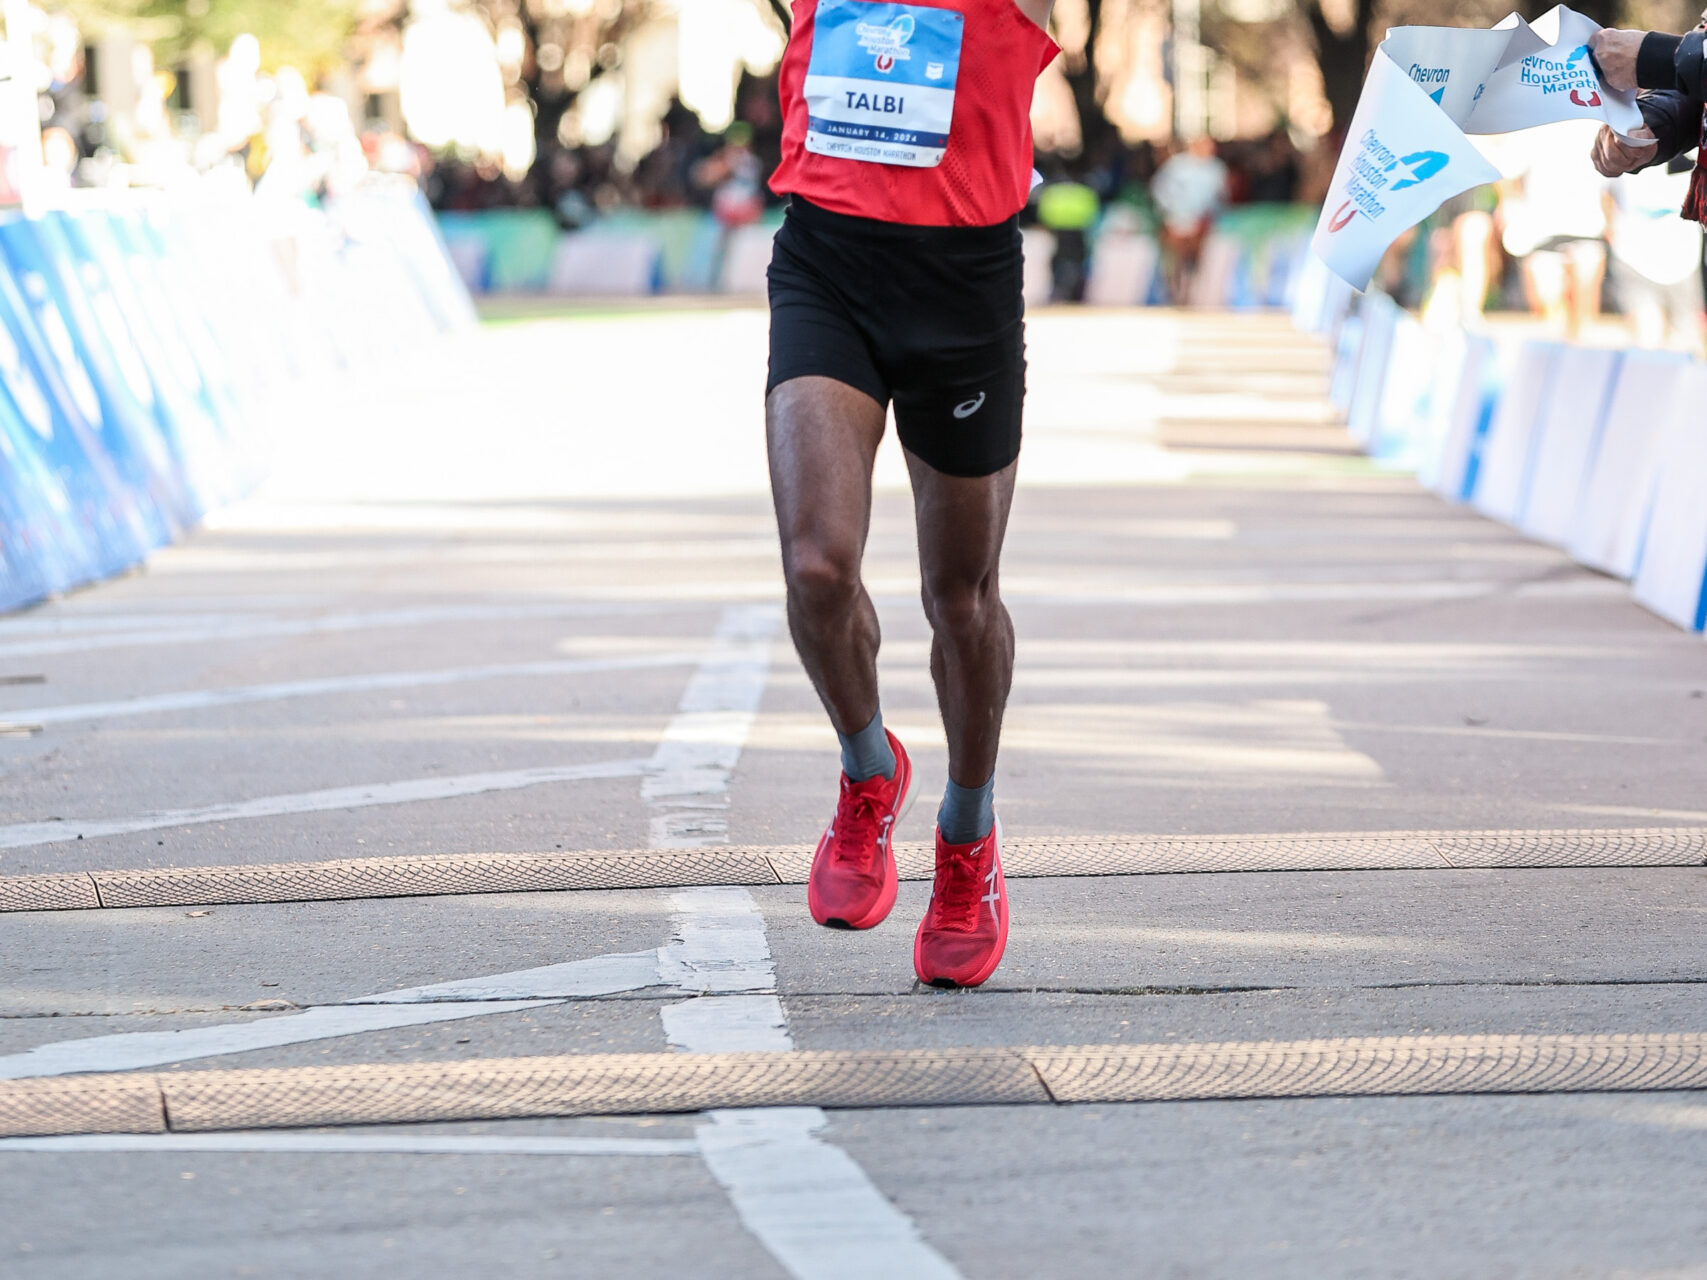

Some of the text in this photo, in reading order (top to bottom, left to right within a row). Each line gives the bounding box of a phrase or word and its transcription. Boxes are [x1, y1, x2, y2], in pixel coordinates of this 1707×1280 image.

[1408, 63, 1450, 83] Chevron
[1520, 66, 1589, 84] Houston
[845, 91, 904, 115] TALBI
[827, 124, 918, 143] JANUARY 14, 2024
[1359, 127, 1397, 167] Chevron
[1350, 149, 1389, 191] Houston
[1342, 173, 1387, 220] Marathon
